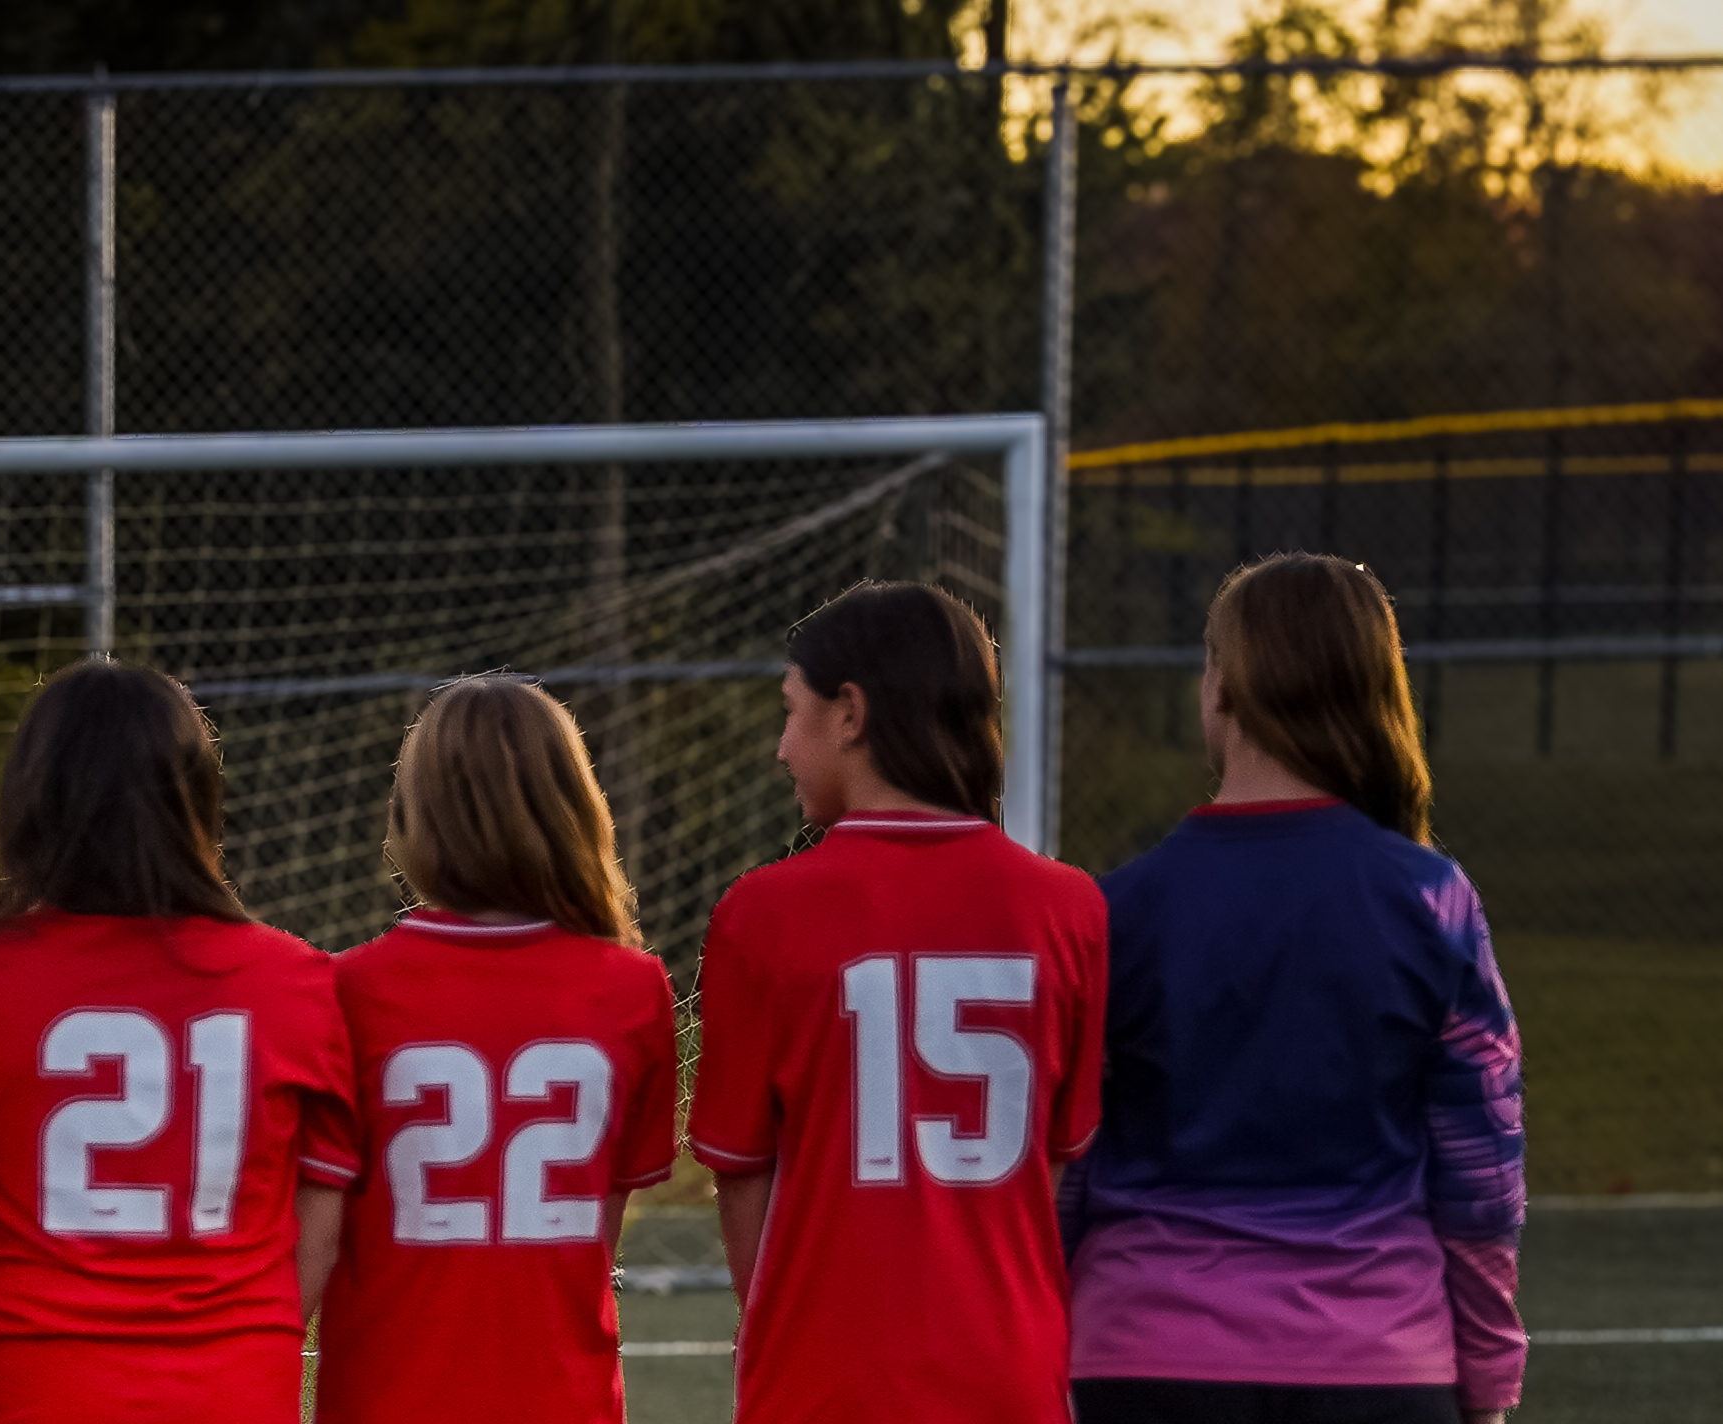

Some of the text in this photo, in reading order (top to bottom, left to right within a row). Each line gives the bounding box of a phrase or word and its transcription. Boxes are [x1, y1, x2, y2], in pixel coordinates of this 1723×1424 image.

[40, 1008, 250, 1235] 21
[383, 1040, 614, 1244] 22
[842, 954, 1036, 1184] 15
